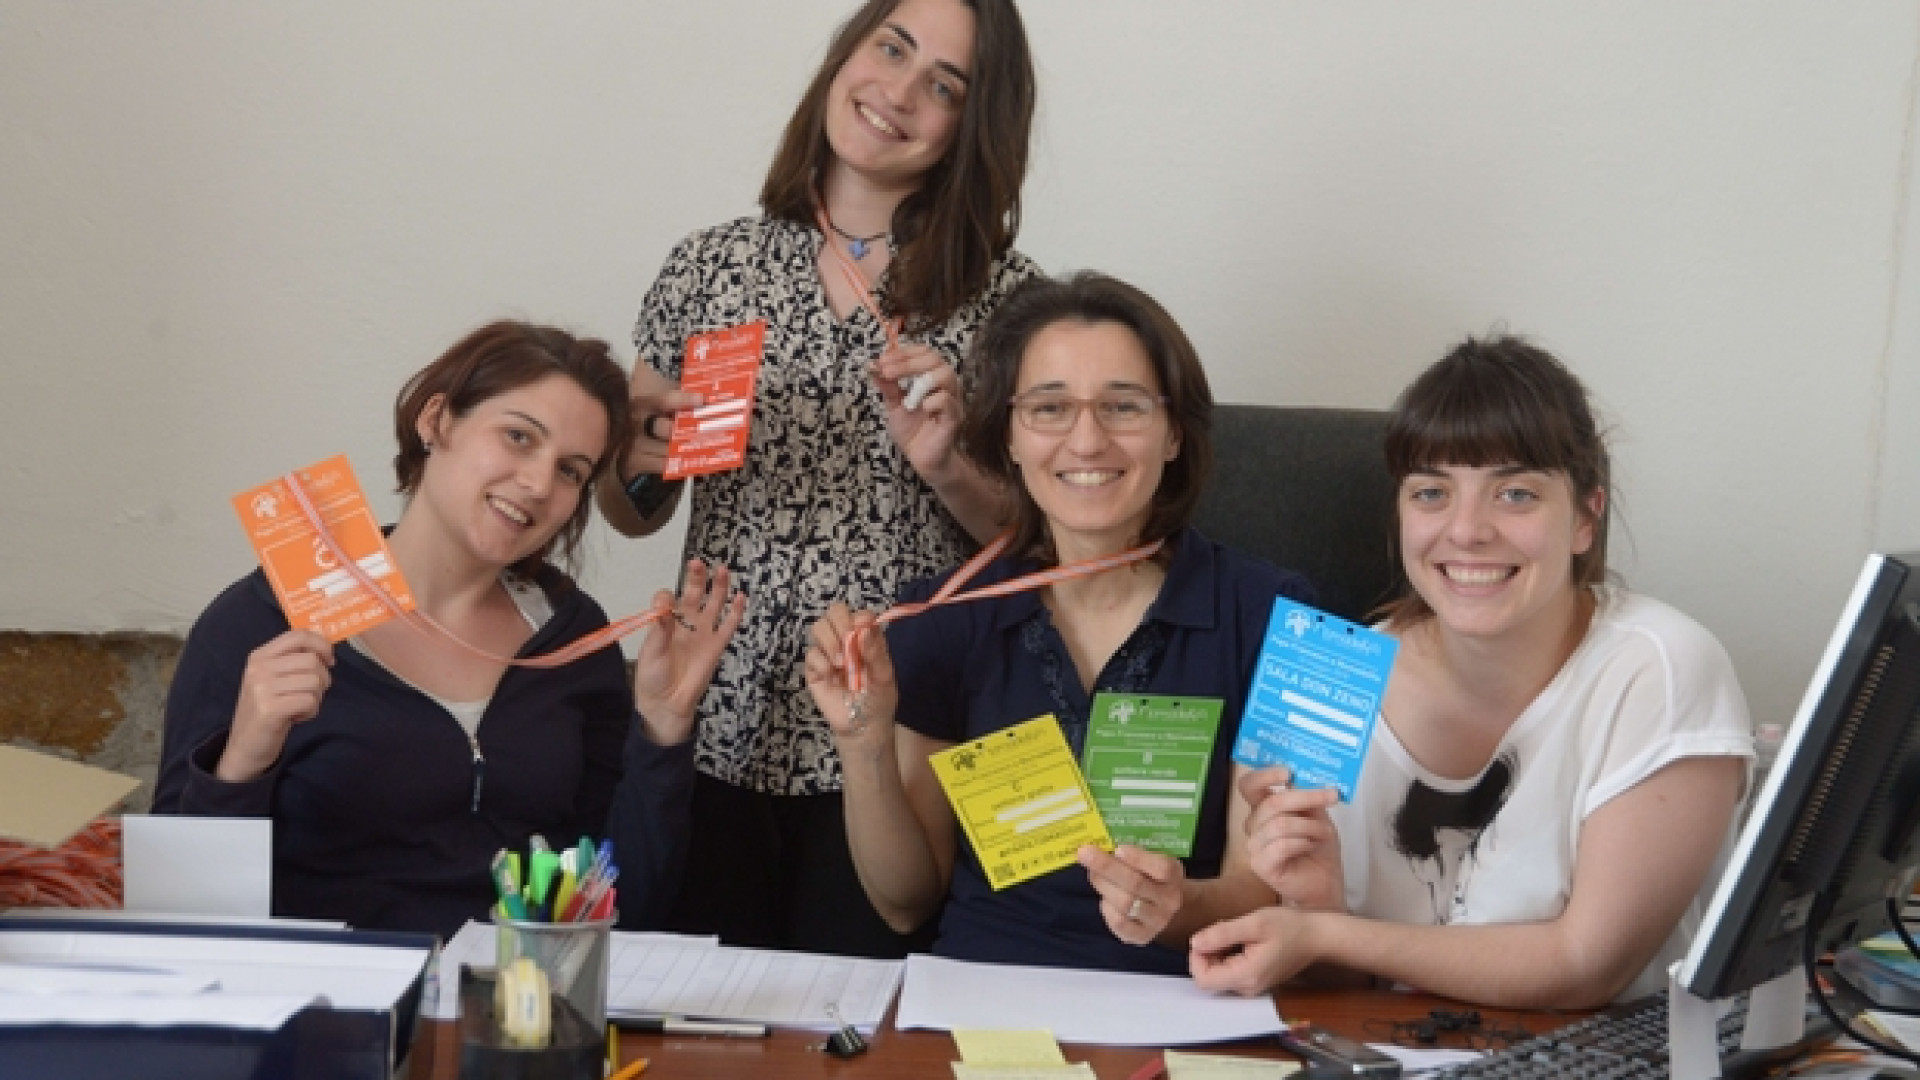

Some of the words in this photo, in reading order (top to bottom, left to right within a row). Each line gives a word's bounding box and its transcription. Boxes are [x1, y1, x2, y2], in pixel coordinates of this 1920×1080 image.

[1265, 662, 1298, 684] SALA
[1300, 676, 1330, 698] DON
[1333, 690, 1370, 712] ZENO
